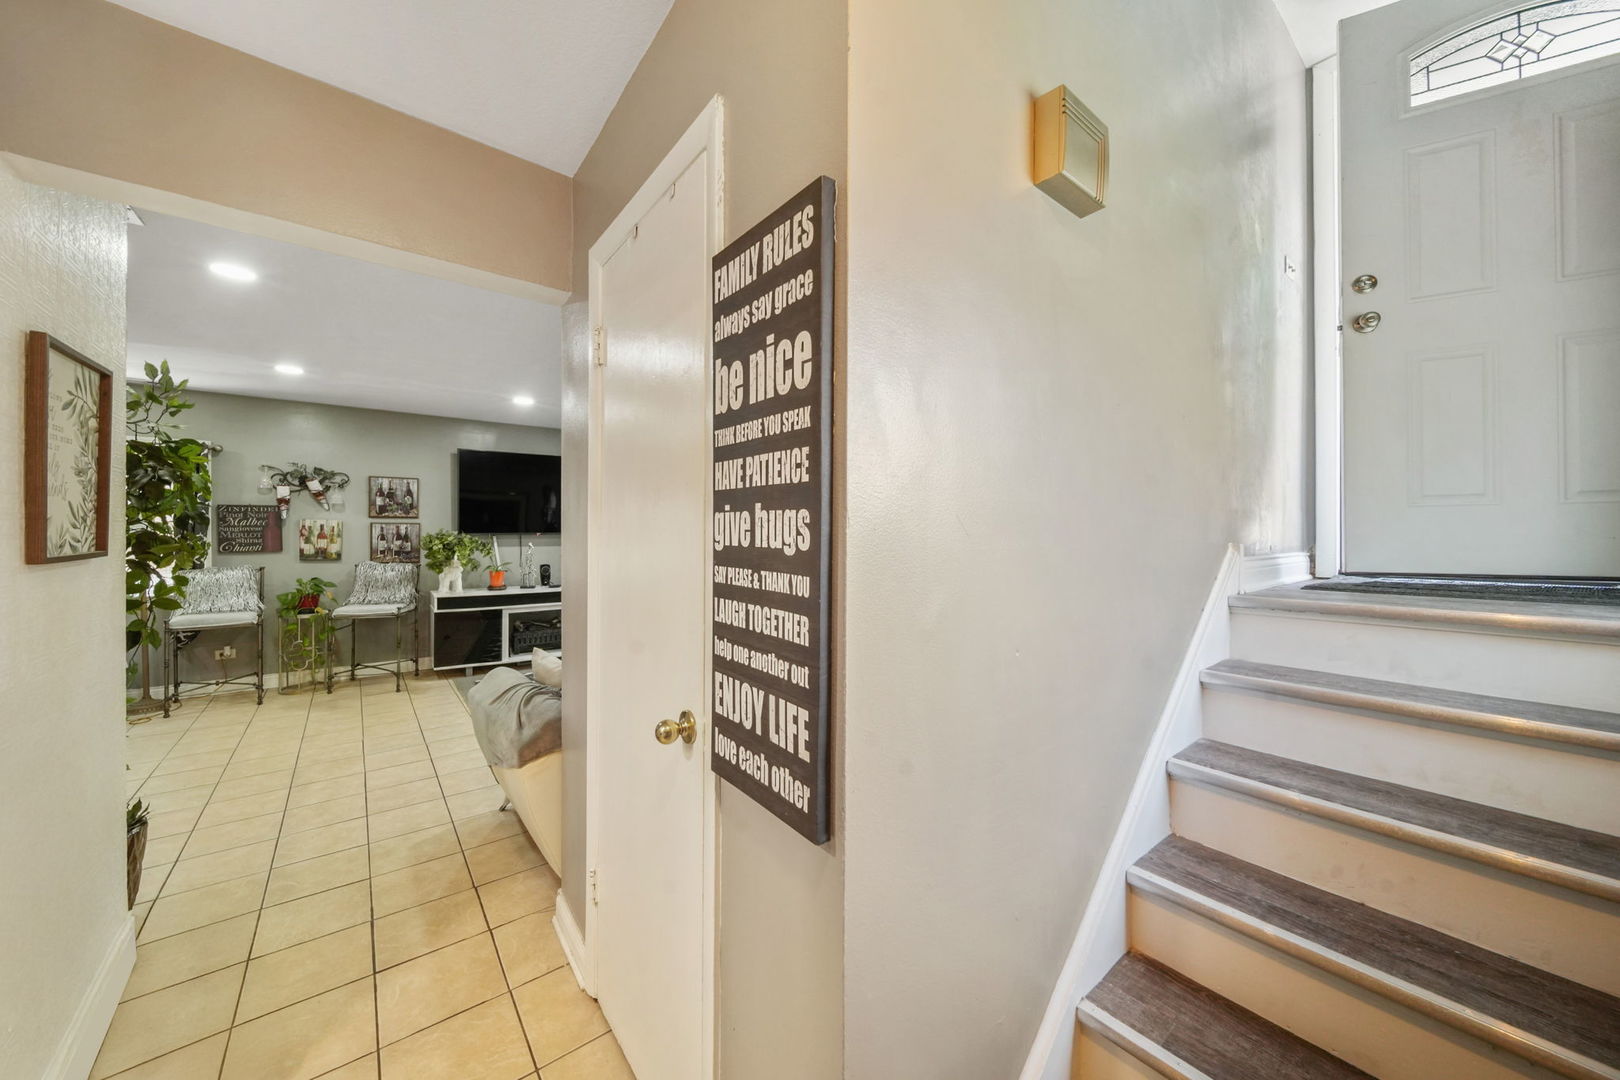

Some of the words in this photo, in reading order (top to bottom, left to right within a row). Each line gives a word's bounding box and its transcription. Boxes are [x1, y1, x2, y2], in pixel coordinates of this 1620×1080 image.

[715, 241, 760, 304] FAMILY
[763, 204, 814, 275] RULES
[715, 304, 750, 343] always
[751, 291, 773, 324] say
[775, 269, 813, 315] grace
[715, 358, 744, 415] be
[749, 330, 812, 404] nice
[715, 426, 735, 448] THINK
[736, 418, 762, 443] BEFORE
[764, 413, 782, 436] YOU
[782, 405, 811, 433] SPEAK
[715, 458, 743, 490] HAVE
[746, 446, 809, 487] PATIENCE
[714, 505, 750, 551] give
[755, 503, 810, 556] hugs
[715, 565, 727, 584] SAY
[728, 567, 752, 588] PLEASE
[753, 572, 760, 589] &
[761, 570, 790, 594] THANK
[791, 574, 810, 598] YOU
[714, 597, 746, 629] LAUGH
[748, 604, 809, 647] TOGETHER
[715, 635, 732, 661] help
[733, 644, 749, 666] one
[750, 650, 789, 680] another
[791, 664, 809, 689] out
[715, 671, 764, 736] ENJOY
[769, 694, 810, 763] LIFE
[715, 726, 737, 765] love
[739, 745, 769, 786] each
[771, 765, 810, 813] other
